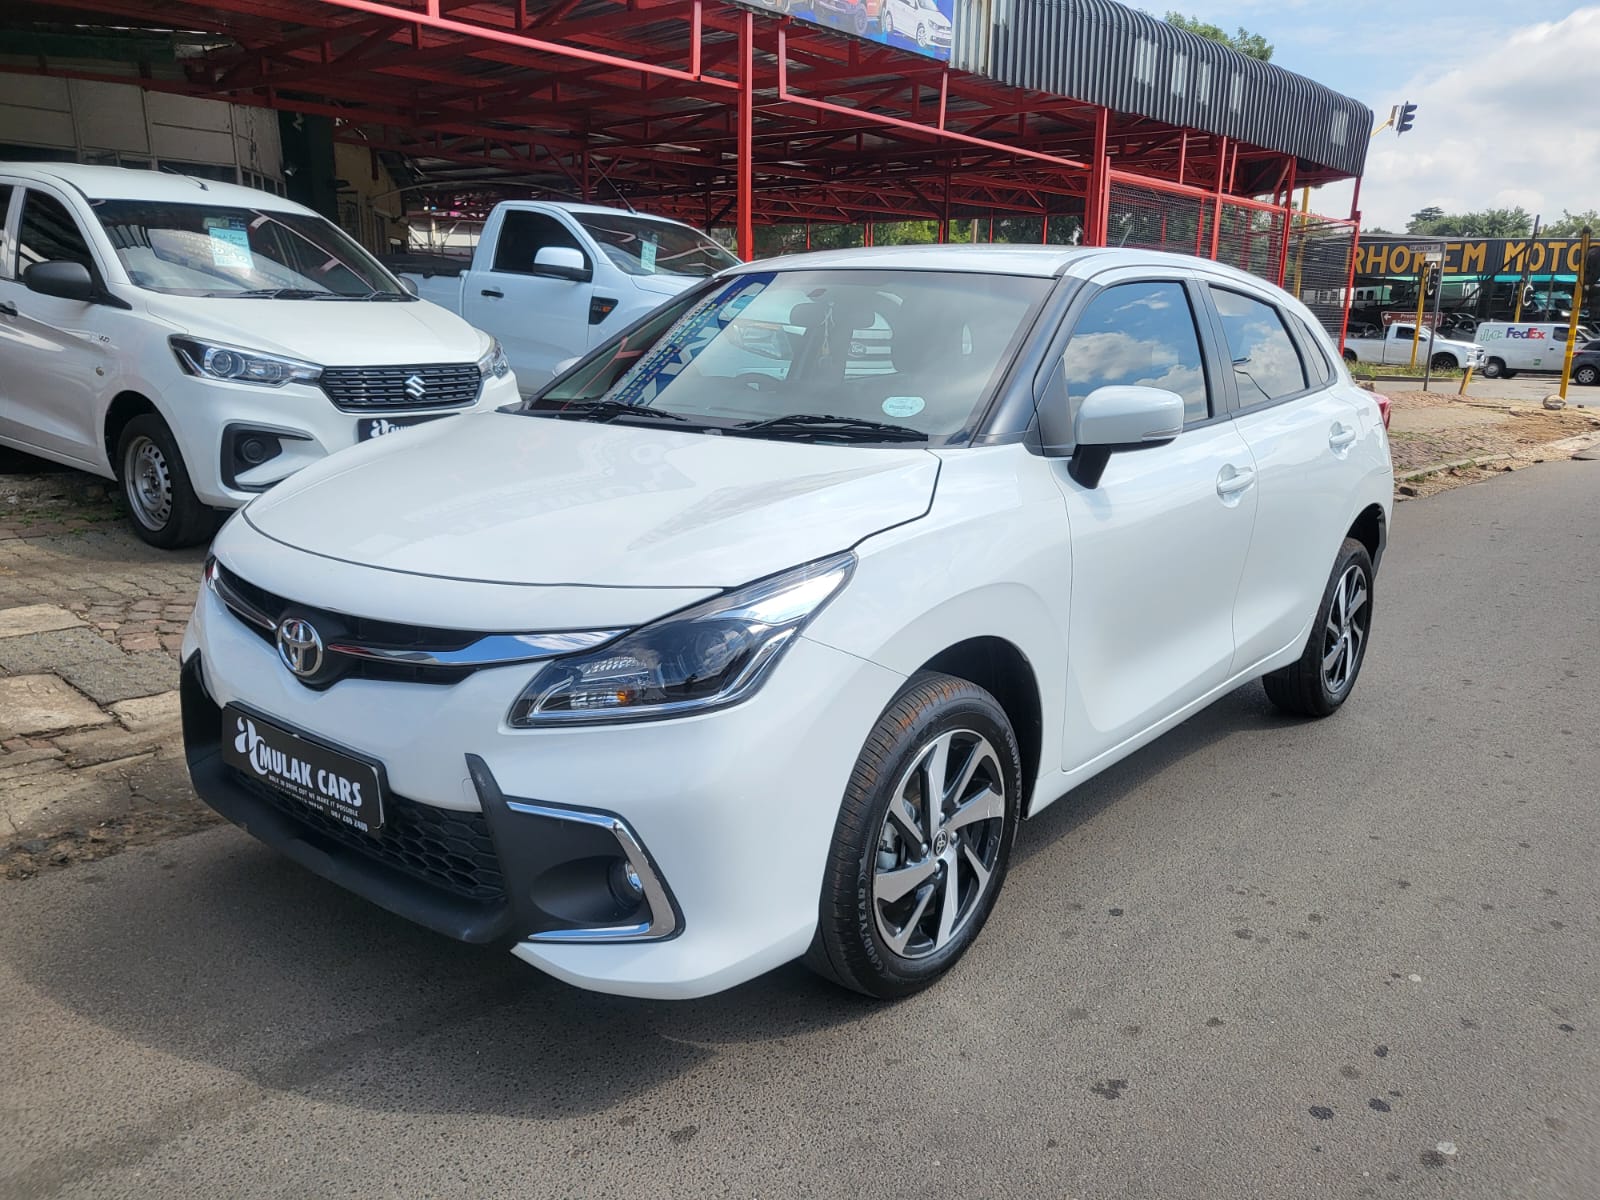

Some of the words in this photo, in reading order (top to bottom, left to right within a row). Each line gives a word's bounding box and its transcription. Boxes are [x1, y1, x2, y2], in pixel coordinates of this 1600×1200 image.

[1344, 242, 1487, 274] RHOEM
[1502, 242, 1600, 273] MOTO
[1506, 327, 1545, 339] FedEx
[317, 769, 362, 807] CARS
[858, 887, 885, 971] GOODYEAR
